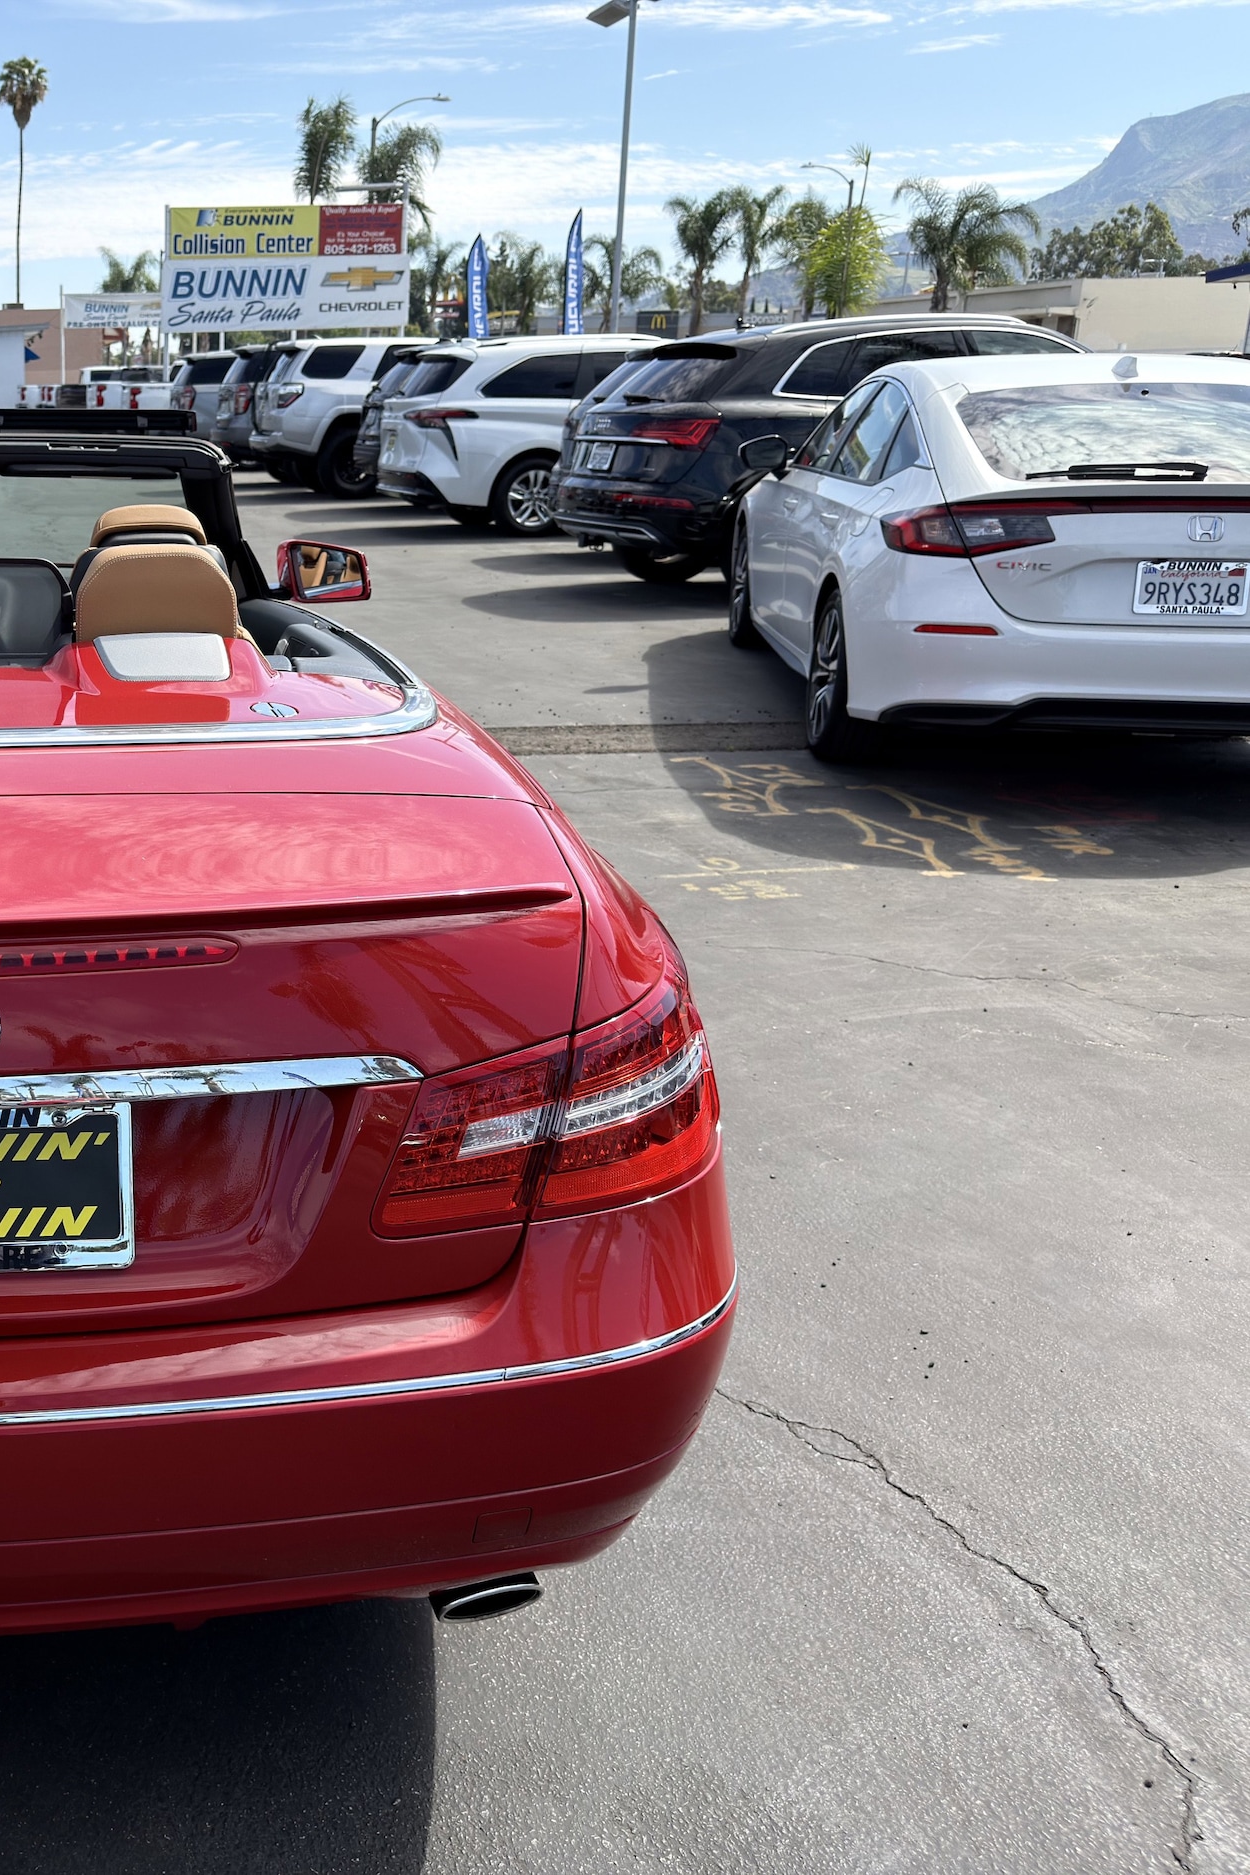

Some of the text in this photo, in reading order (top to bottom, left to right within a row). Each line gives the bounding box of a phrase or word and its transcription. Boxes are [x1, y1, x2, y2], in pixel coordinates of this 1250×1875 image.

[223, 214, 294, 226] BUNNIN
[174, 232, 314, 255] Collision Center
[324, 243, 397, 255] 805-421-1263
[171, 267, 308, 299] BUNNIN
[84, 303, 130, 313] BUNNIN
[319, 301, 405, 313] CHEVROLET
[168, 300, 303, 327] Santa Paula
[996, 561, 1052, 572] CIVIC
[1167, 561, 1222, 571] BUNNIN
[1143, 582, 1240, 606] 9RYS348
